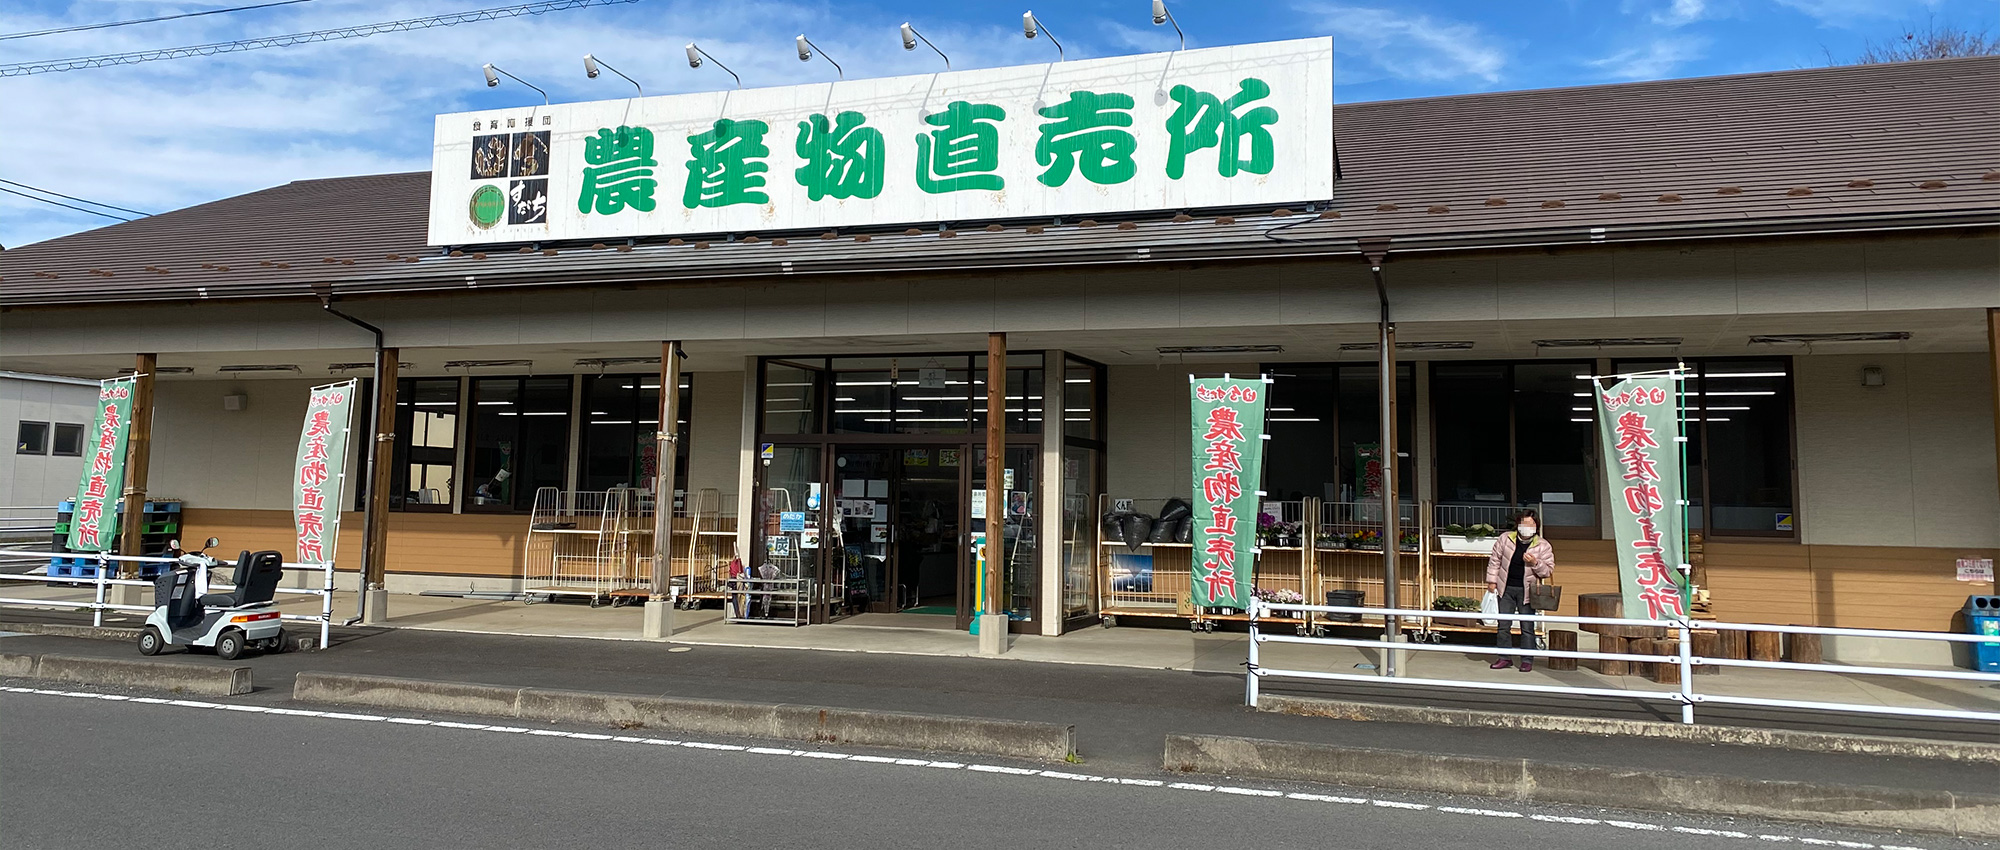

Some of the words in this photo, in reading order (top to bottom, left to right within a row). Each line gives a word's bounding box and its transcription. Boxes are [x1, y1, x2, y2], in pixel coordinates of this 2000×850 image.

[577, 78, 1279, 215] 農産物直売所
[509, 180, 547, 223] すだち
[774, 537, 789, 553] 炭
